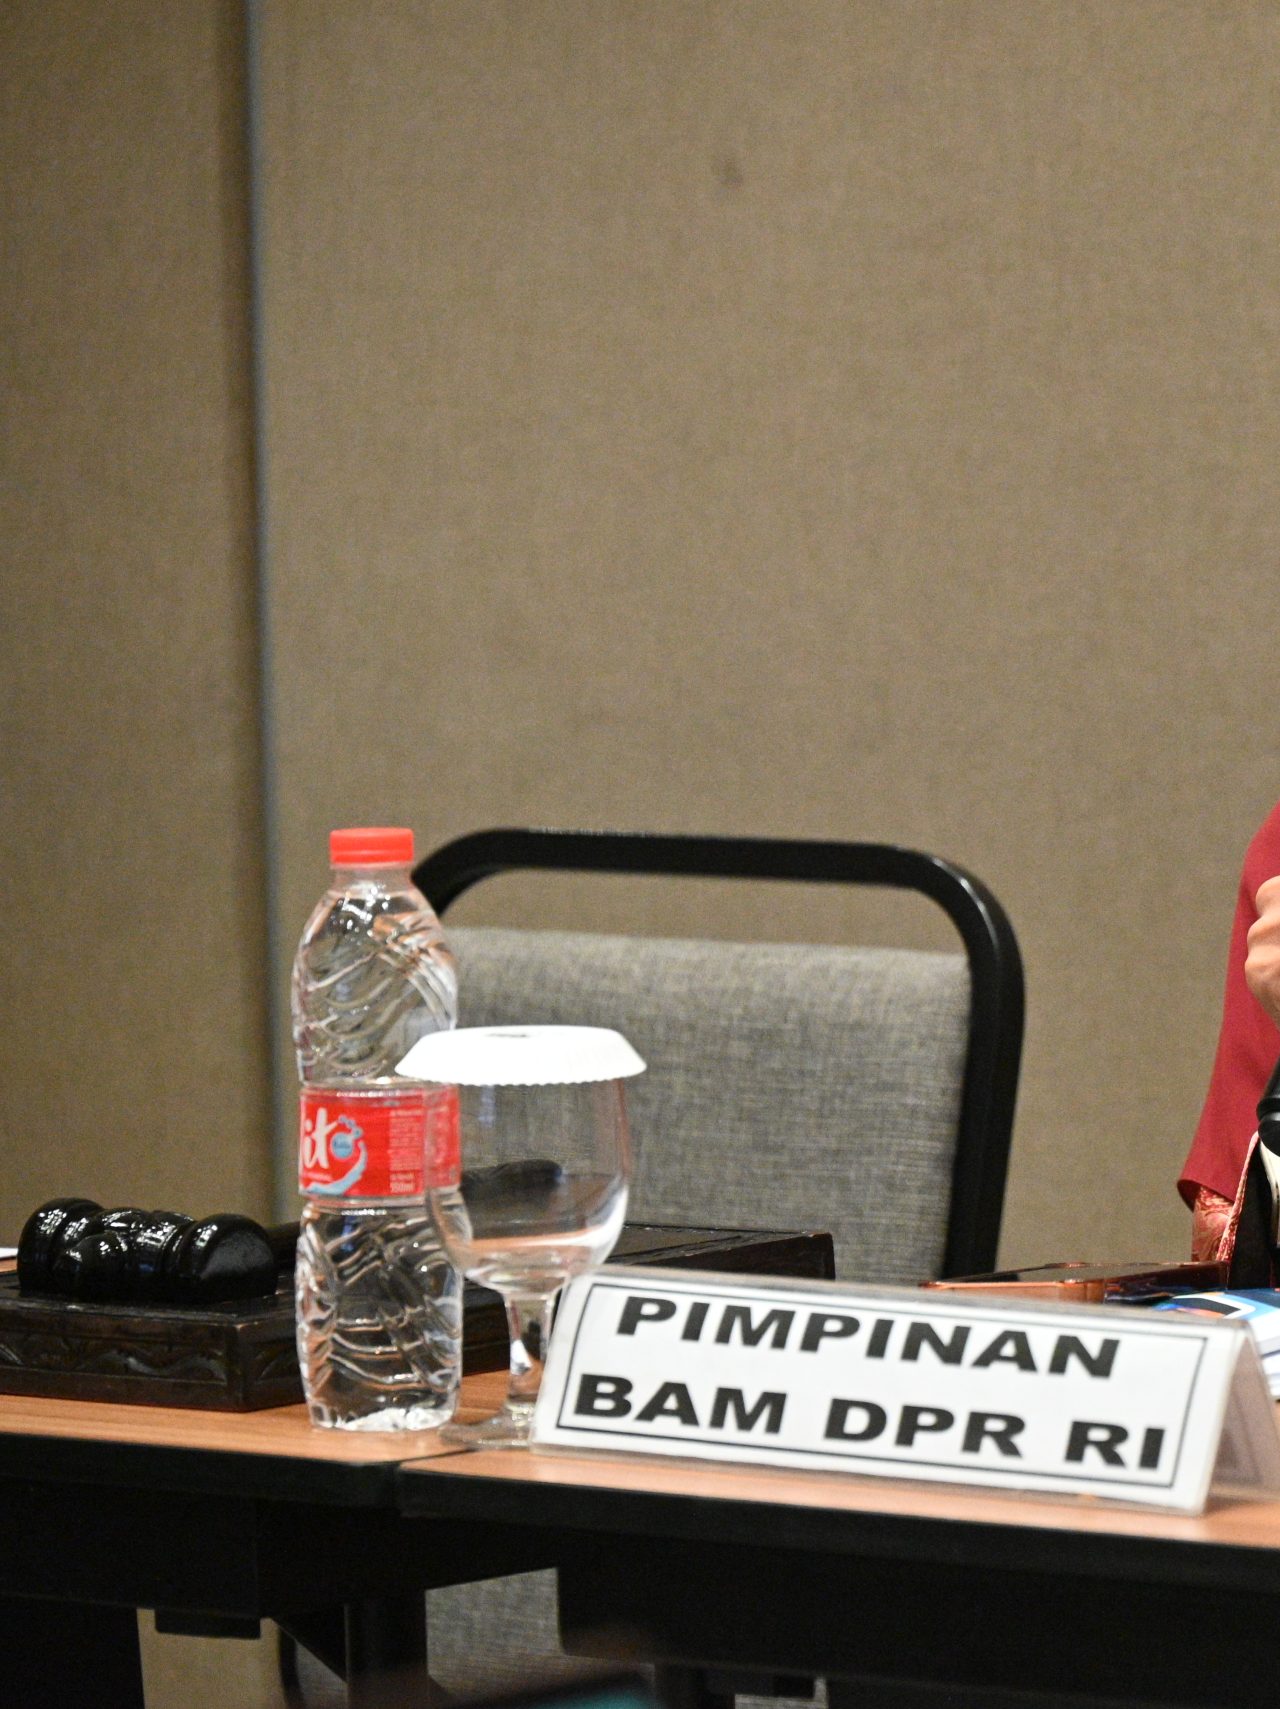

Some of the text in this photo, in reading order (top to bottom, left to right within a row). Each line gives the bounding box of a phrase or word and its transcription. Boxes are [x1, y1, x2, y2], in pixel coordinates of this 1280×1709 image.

[616, 1296, 1120, 1378] PIMPINAN
[574, 1374, 1165, 1469] BAM DPR RI
